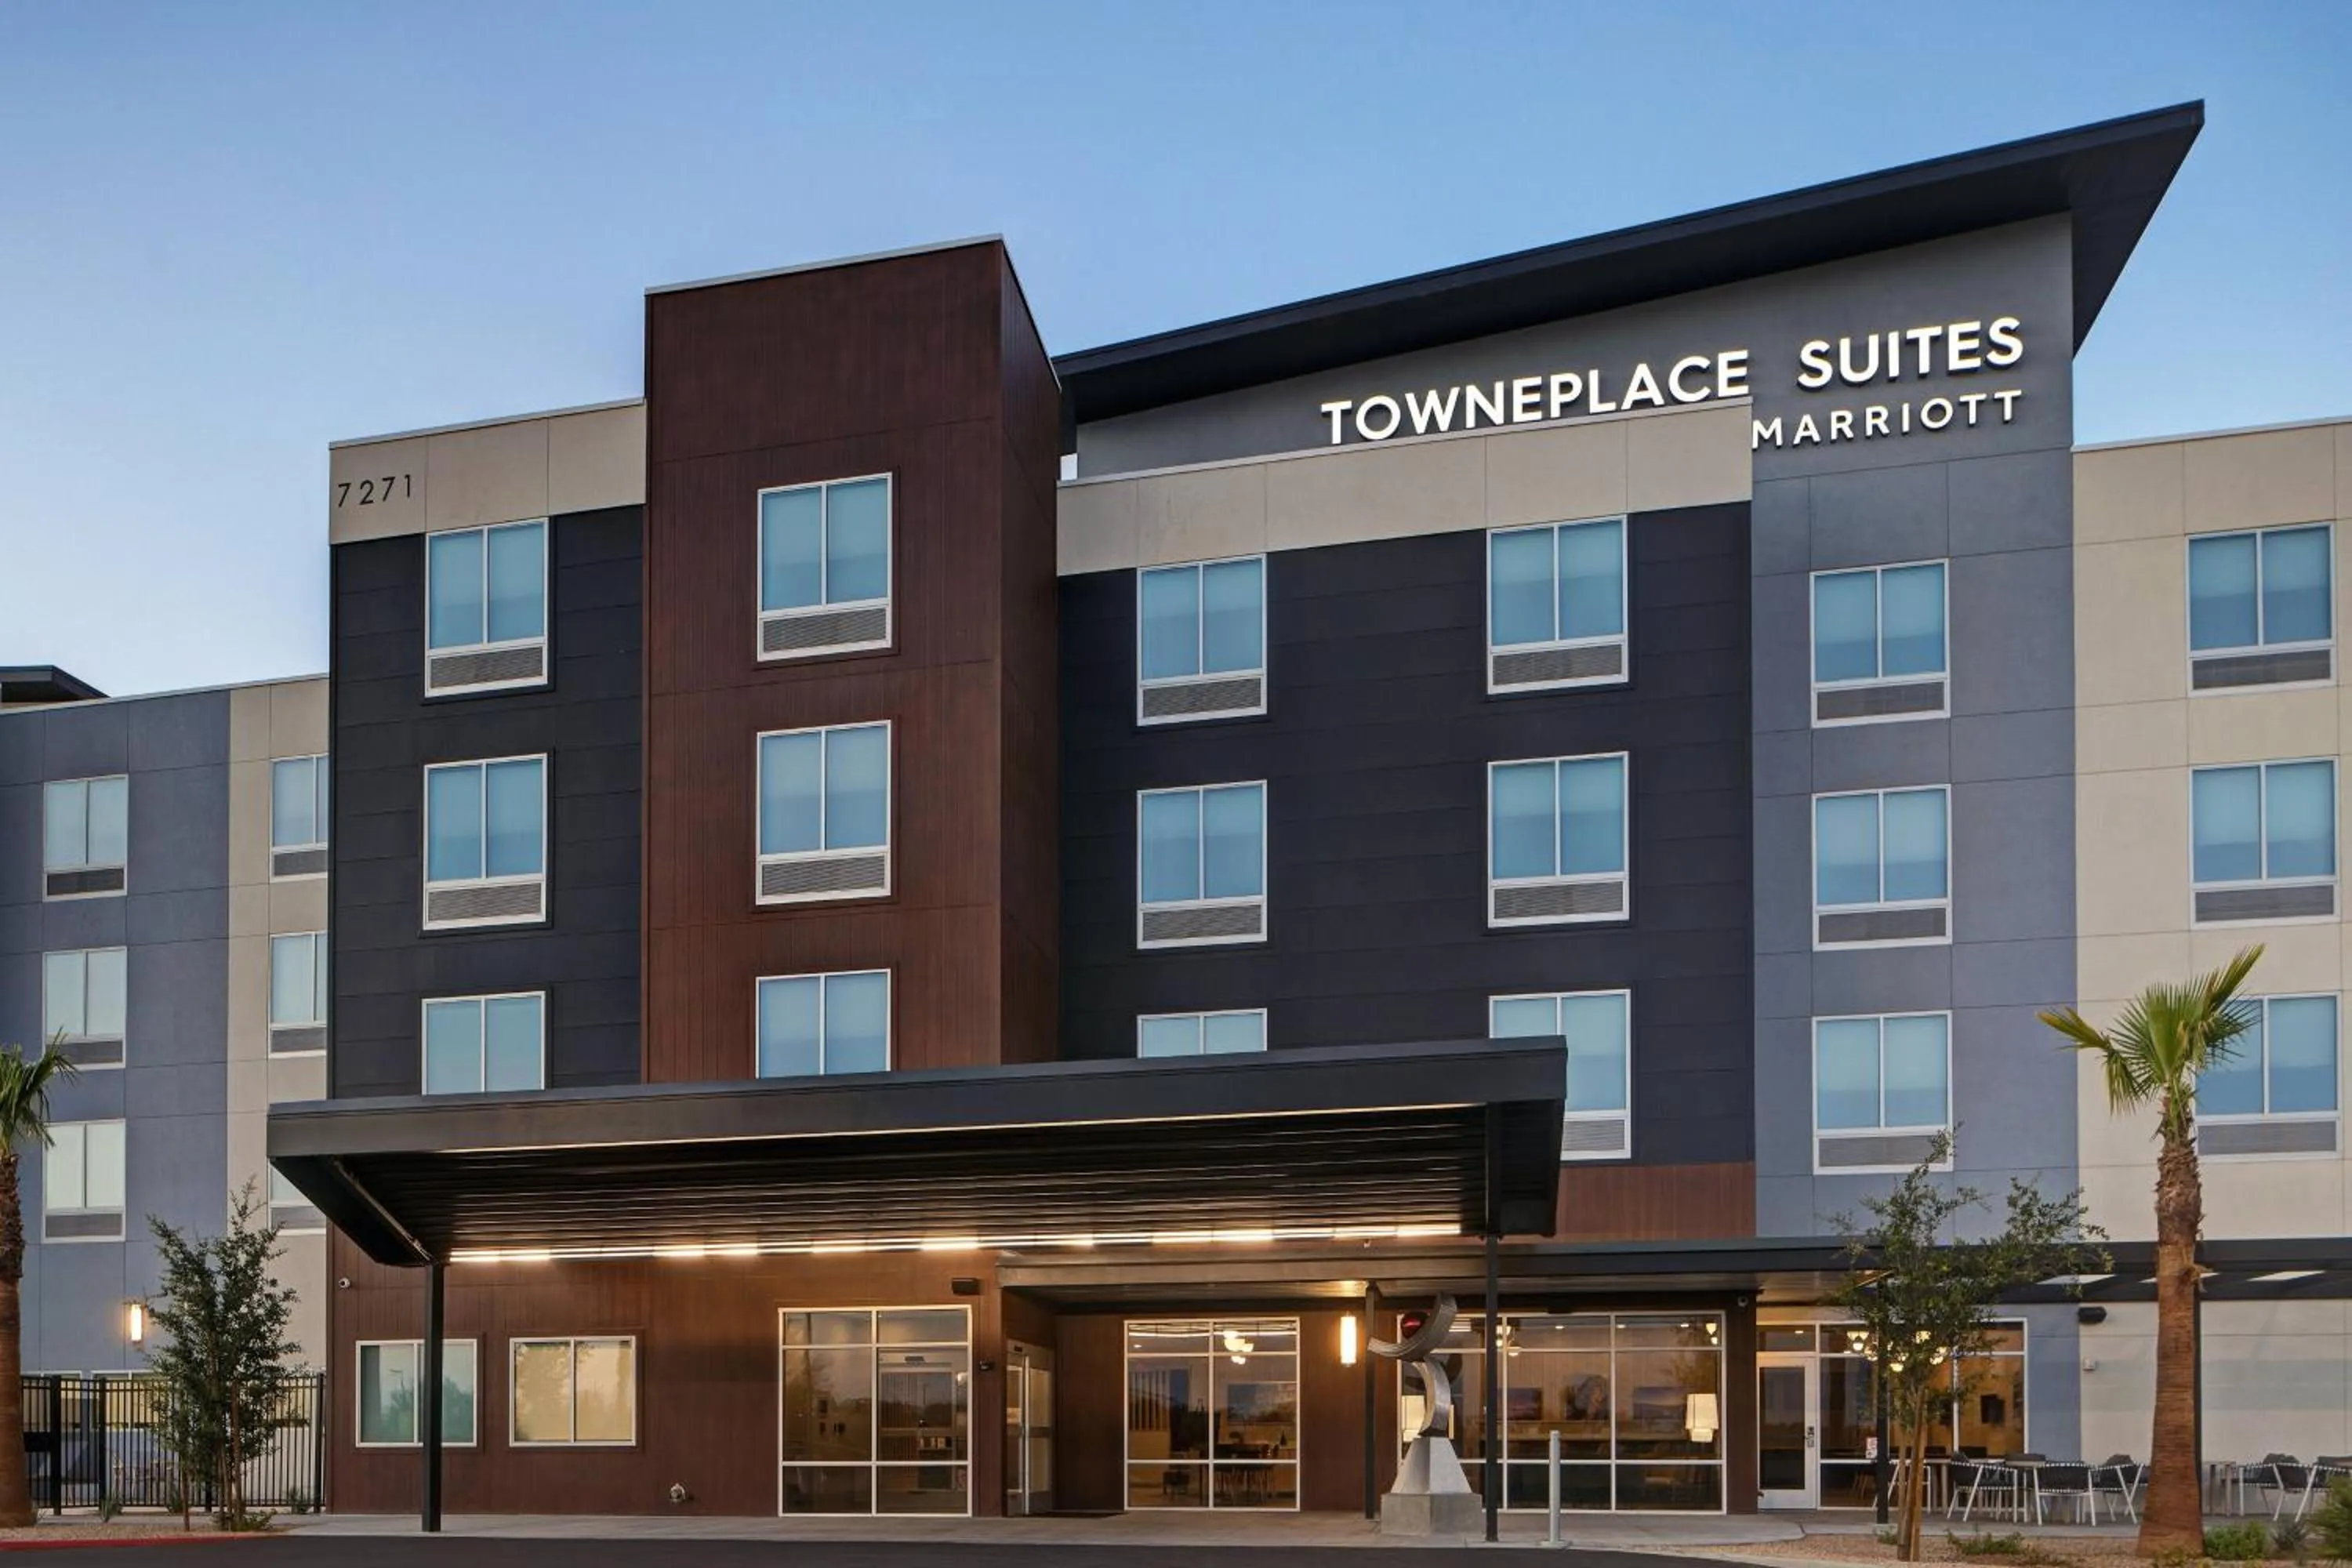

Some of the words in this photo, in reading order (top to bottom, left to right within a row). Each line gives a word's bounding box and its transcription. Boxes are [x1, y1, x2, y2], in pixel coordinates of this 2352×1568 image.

[1321, 350, 1749, 445] TOWNEPLACE
[1797, 317, 2024, 387] SUITES
[1751, 390, 2022, 449] MARRIOTT
[337, 474, 411, 508] 7271
